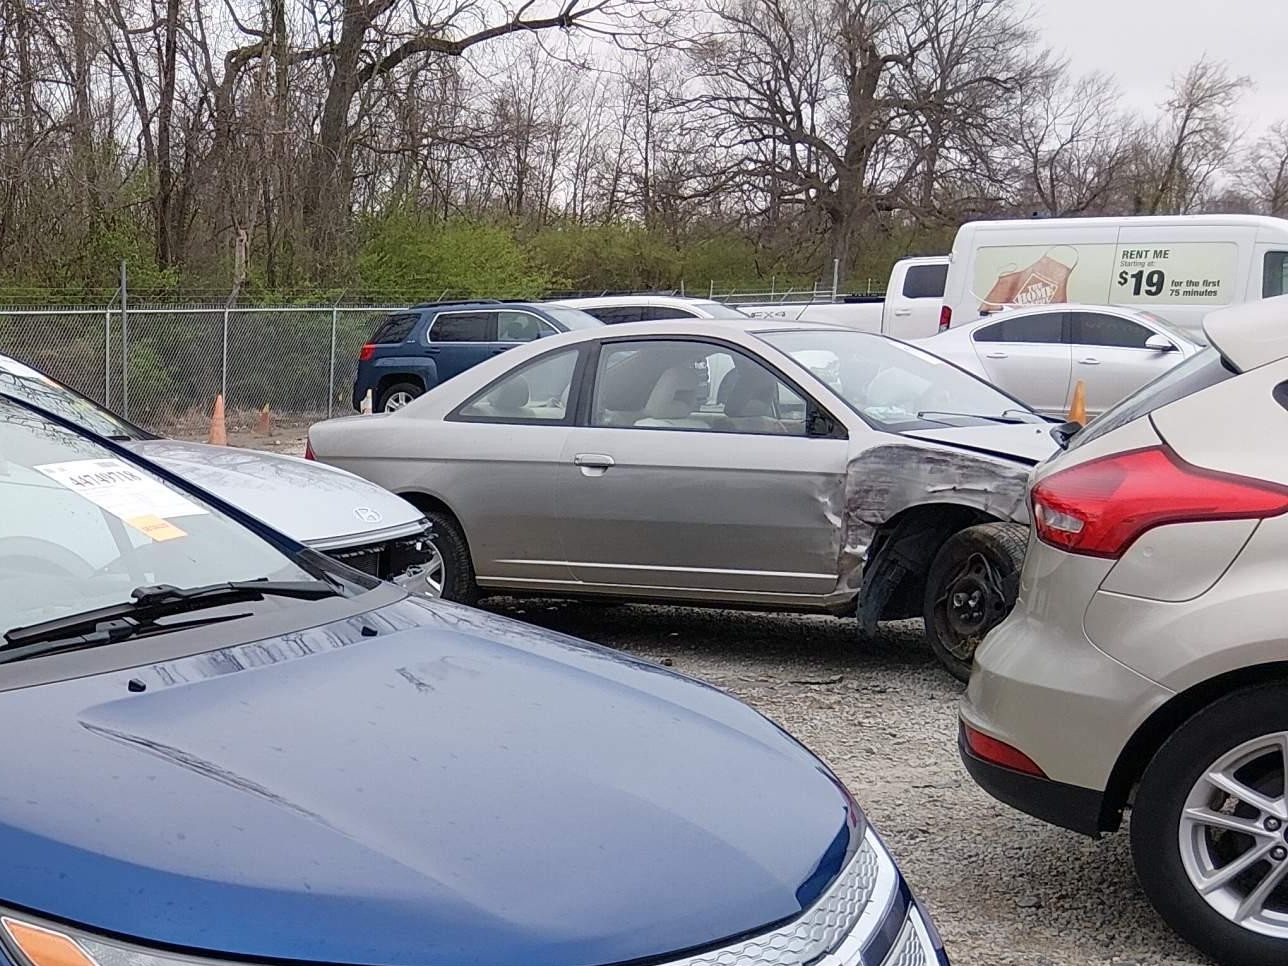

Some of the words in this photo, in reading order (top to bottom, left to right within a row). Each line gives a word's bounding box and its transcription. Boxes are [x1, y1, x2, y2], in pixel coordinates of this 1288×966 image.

[1122, 250, 1150, 259] RENT
[1152, 250, 1170, 258] ME
[1118, 270, 1165, 296] $19
